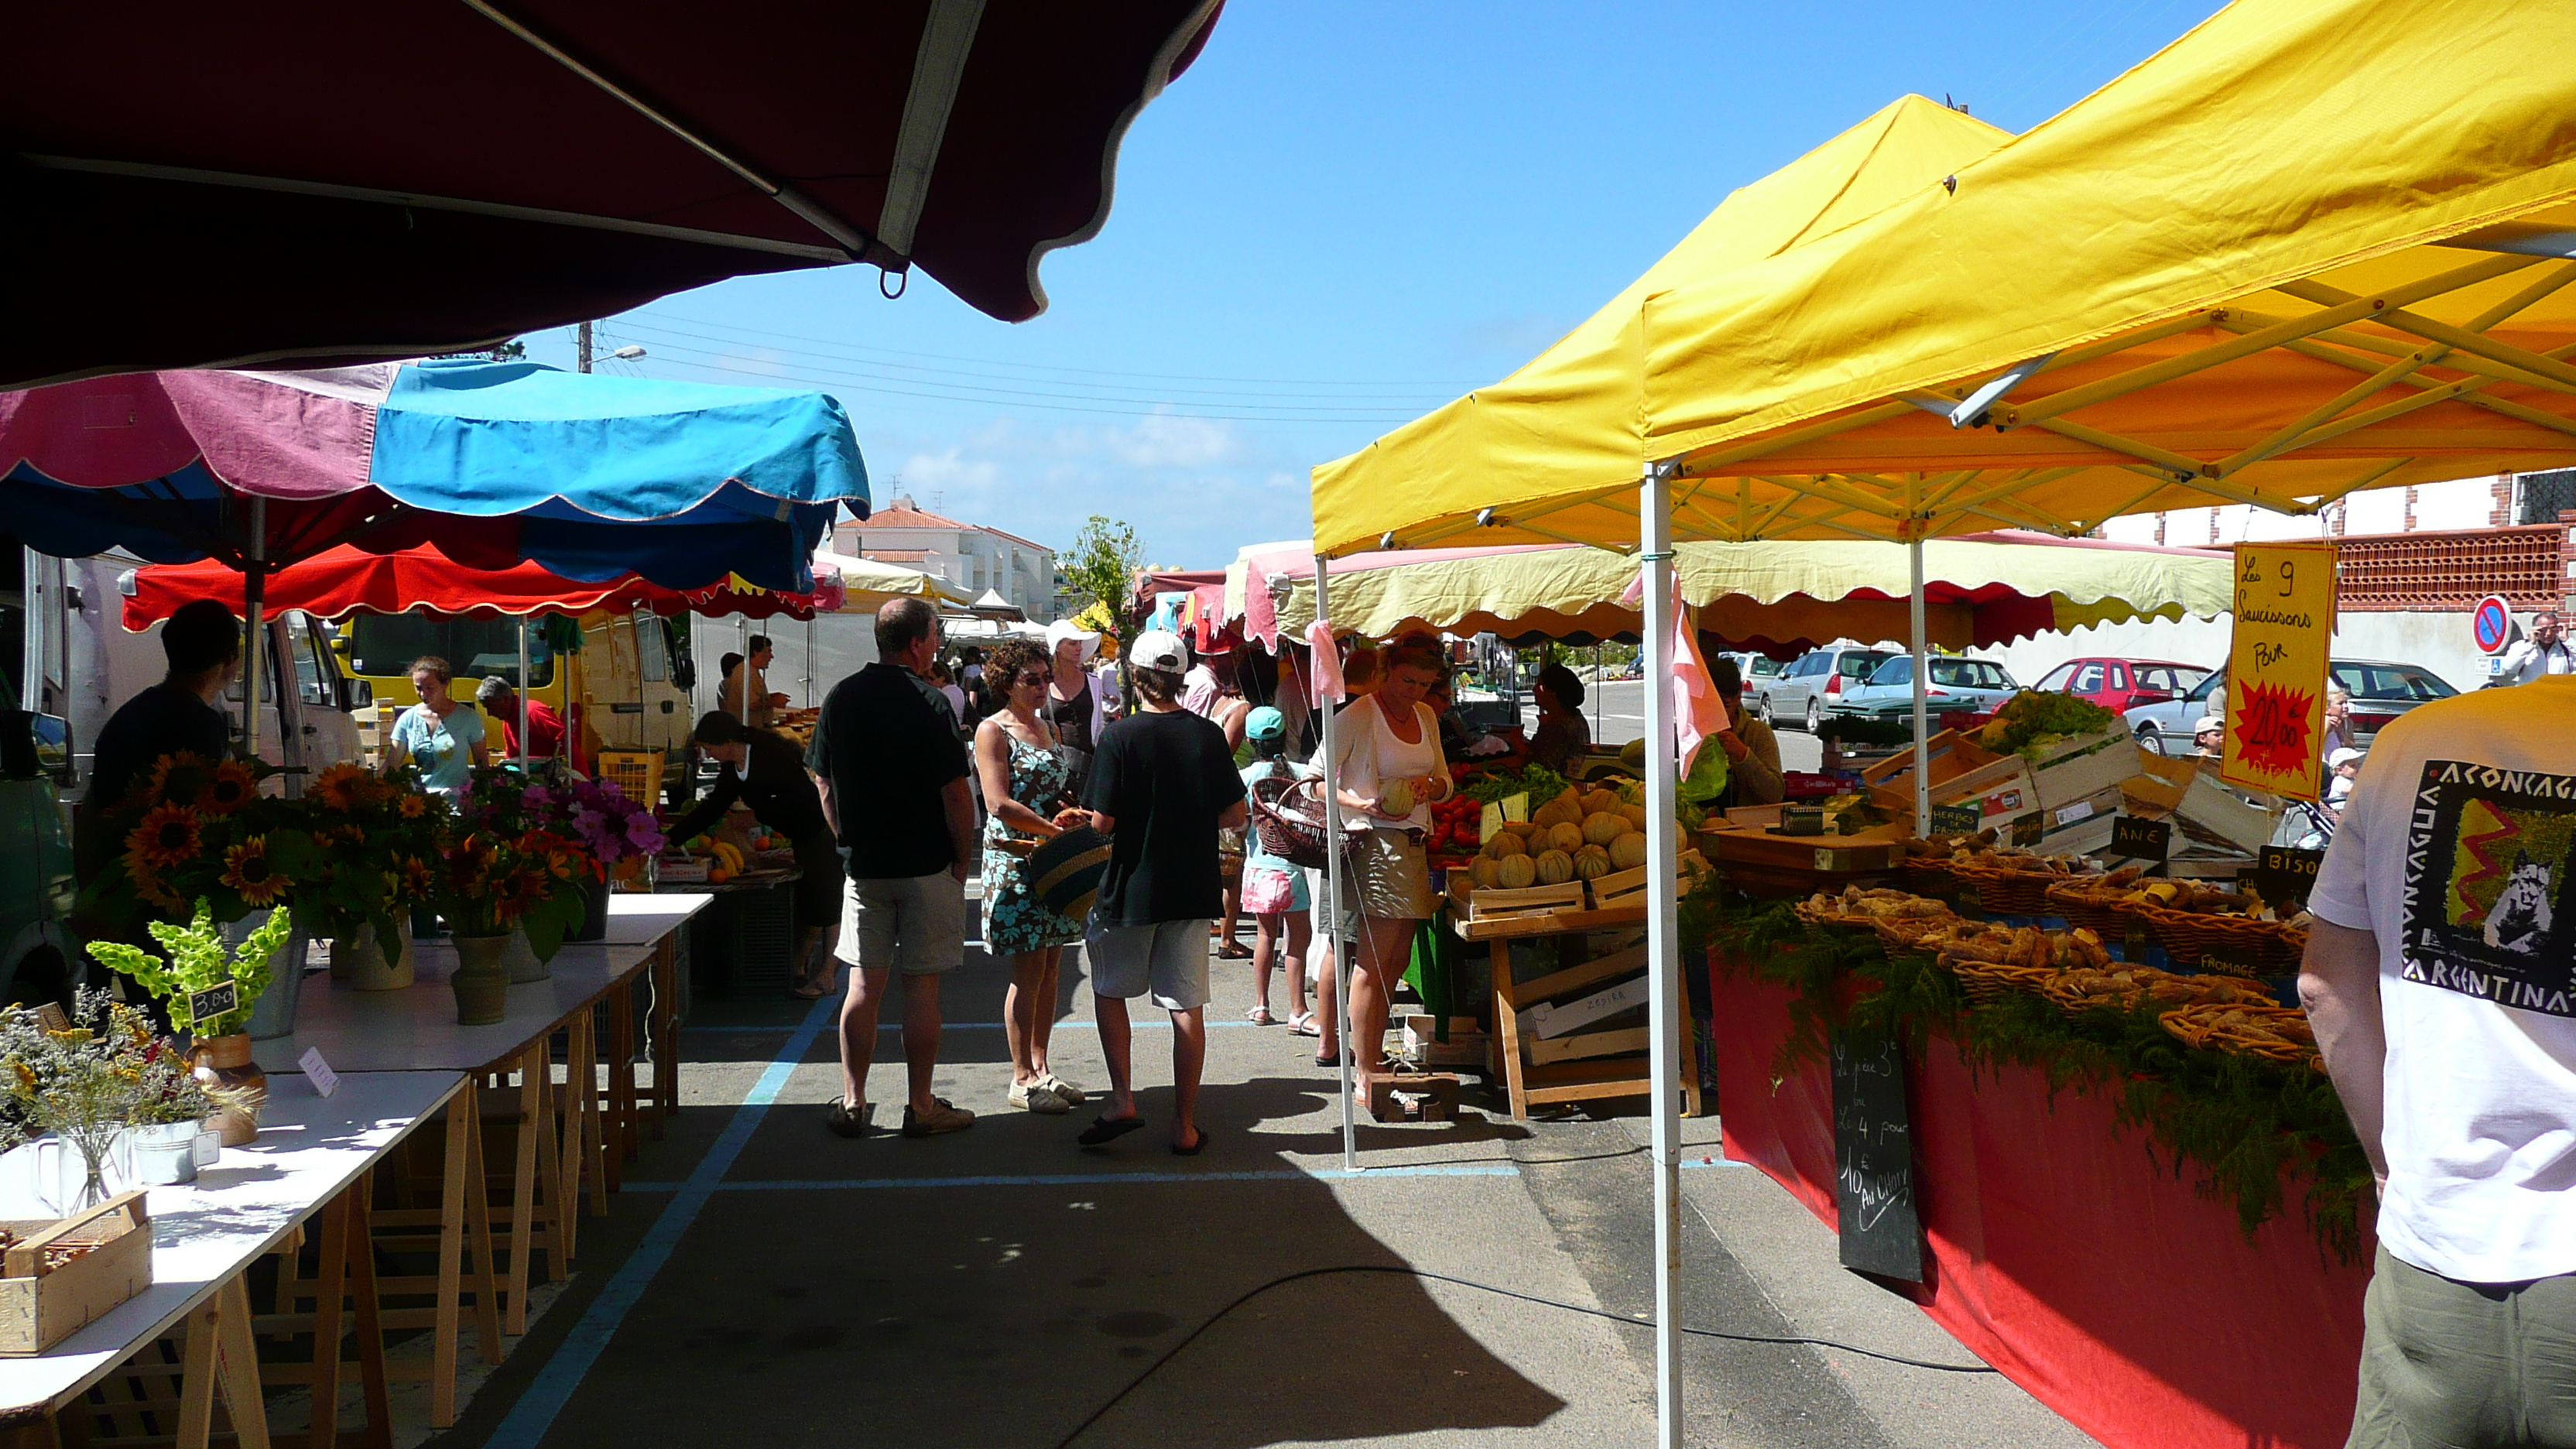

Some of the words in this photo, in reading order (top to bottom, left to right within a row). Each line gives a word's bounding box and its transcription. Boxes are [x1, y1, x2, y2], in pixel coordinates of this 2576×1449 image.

[2279, 561, 2294, 597] 9
[2239, 589, 2311, 629] Saucissons
[2438, 762, 2576, 800] ACONCAG
[1934, 810, 1975, 824] HERBES
[2269, 854, 2318, 875] BISO
[2201, 954, 2257, 978] FROMAGE
[2403, 957, 2569, 1013] ARGENTINA
[1858, 1116, 1868, 1140] 4
[1879, 1121, 1908, 1146] pour
